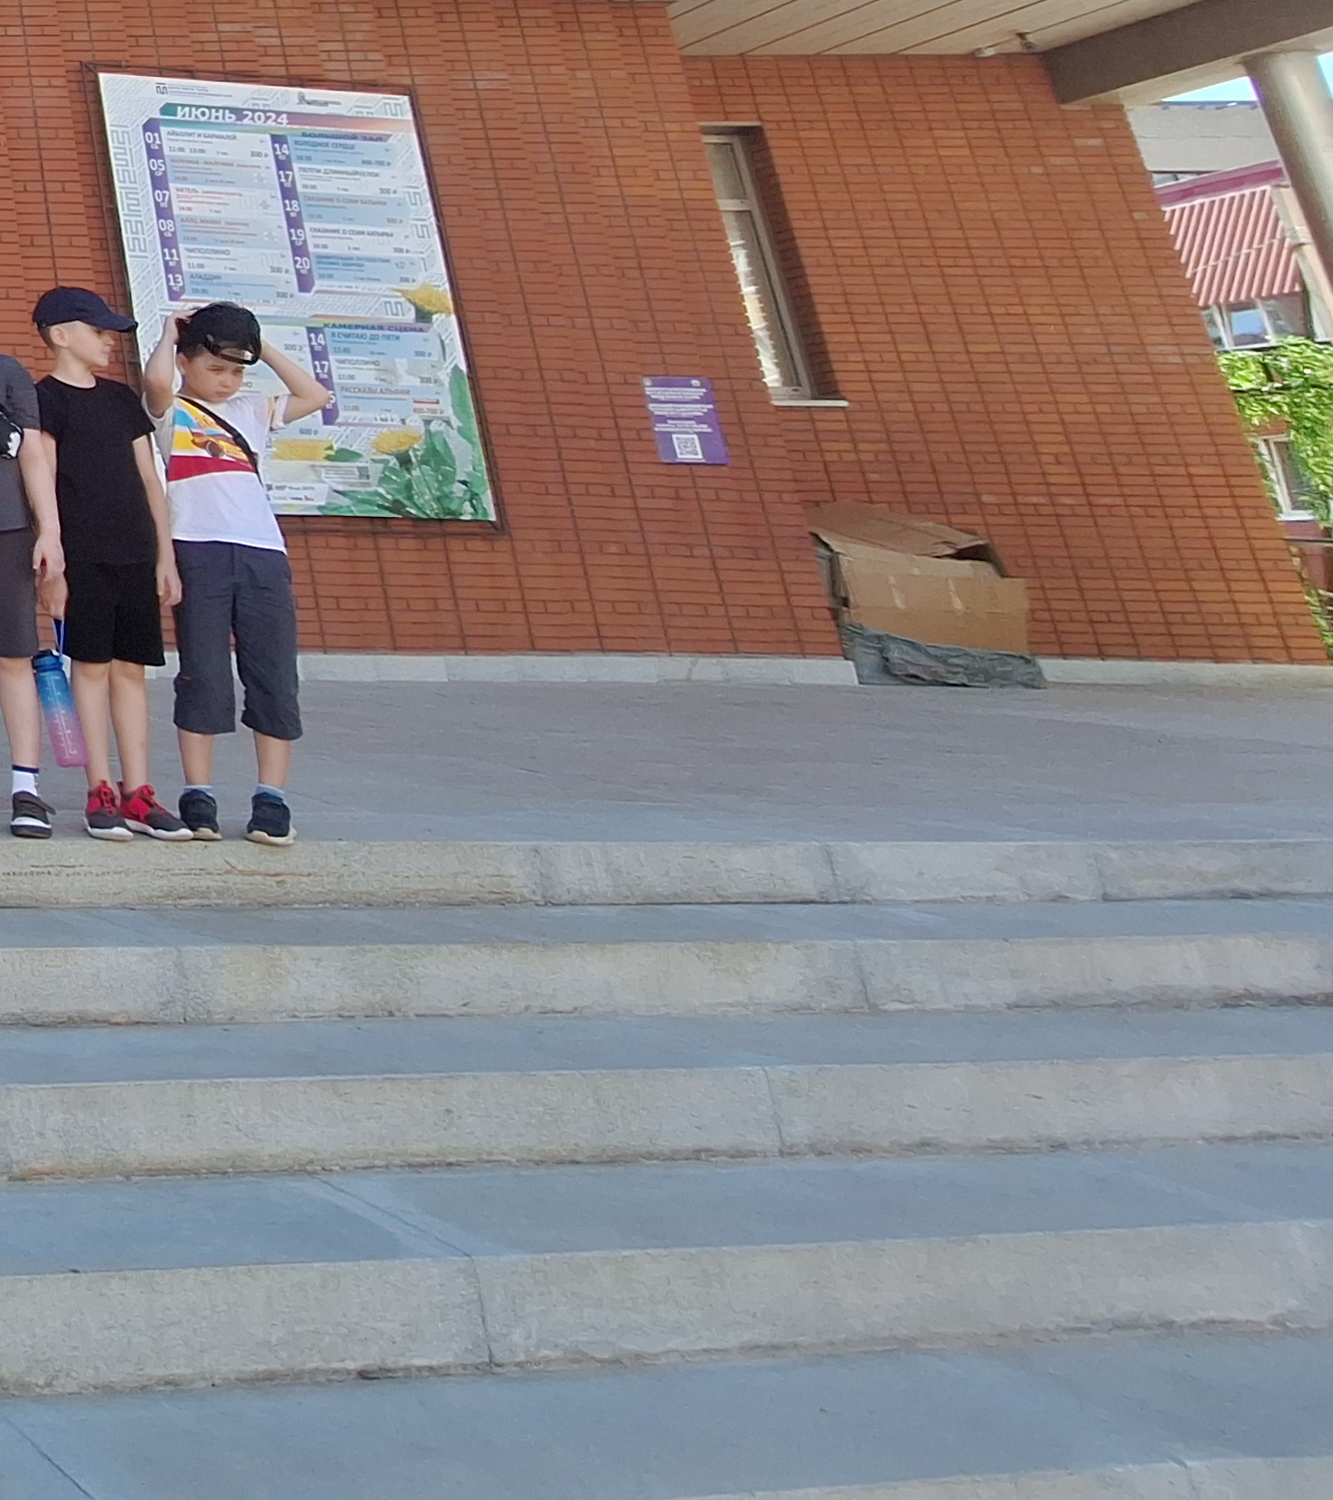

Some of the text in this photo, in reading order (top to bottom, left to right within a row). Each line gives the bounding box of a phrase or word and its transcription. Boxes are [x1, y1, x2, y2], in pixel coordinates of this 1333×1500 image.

[176, 106, 289, 126] ИЮНЬ 2024
[145, 132, 162, 145] 01
[274, 143, 290, 156] 14
[150, 159, 166, 171] 05
[278, 171, 293, 182] 17
[154, 190, 170, 203] 07
[284, 200, 300, 212] 18
[159, 220, 175, 232] 08
[290, 229, 305, 241] 19
[163, 248, 180, 261] 11
[294, 257, 311, 270] 20
[168, 274, 184, 287] 13
[323, 323, 386, 332] КАМЕРНАЯ
[309, 333, 326, 346] 14
[337, 332, 368, 340] СЧИТАЮ
[314, 361, 330, 373] 17
